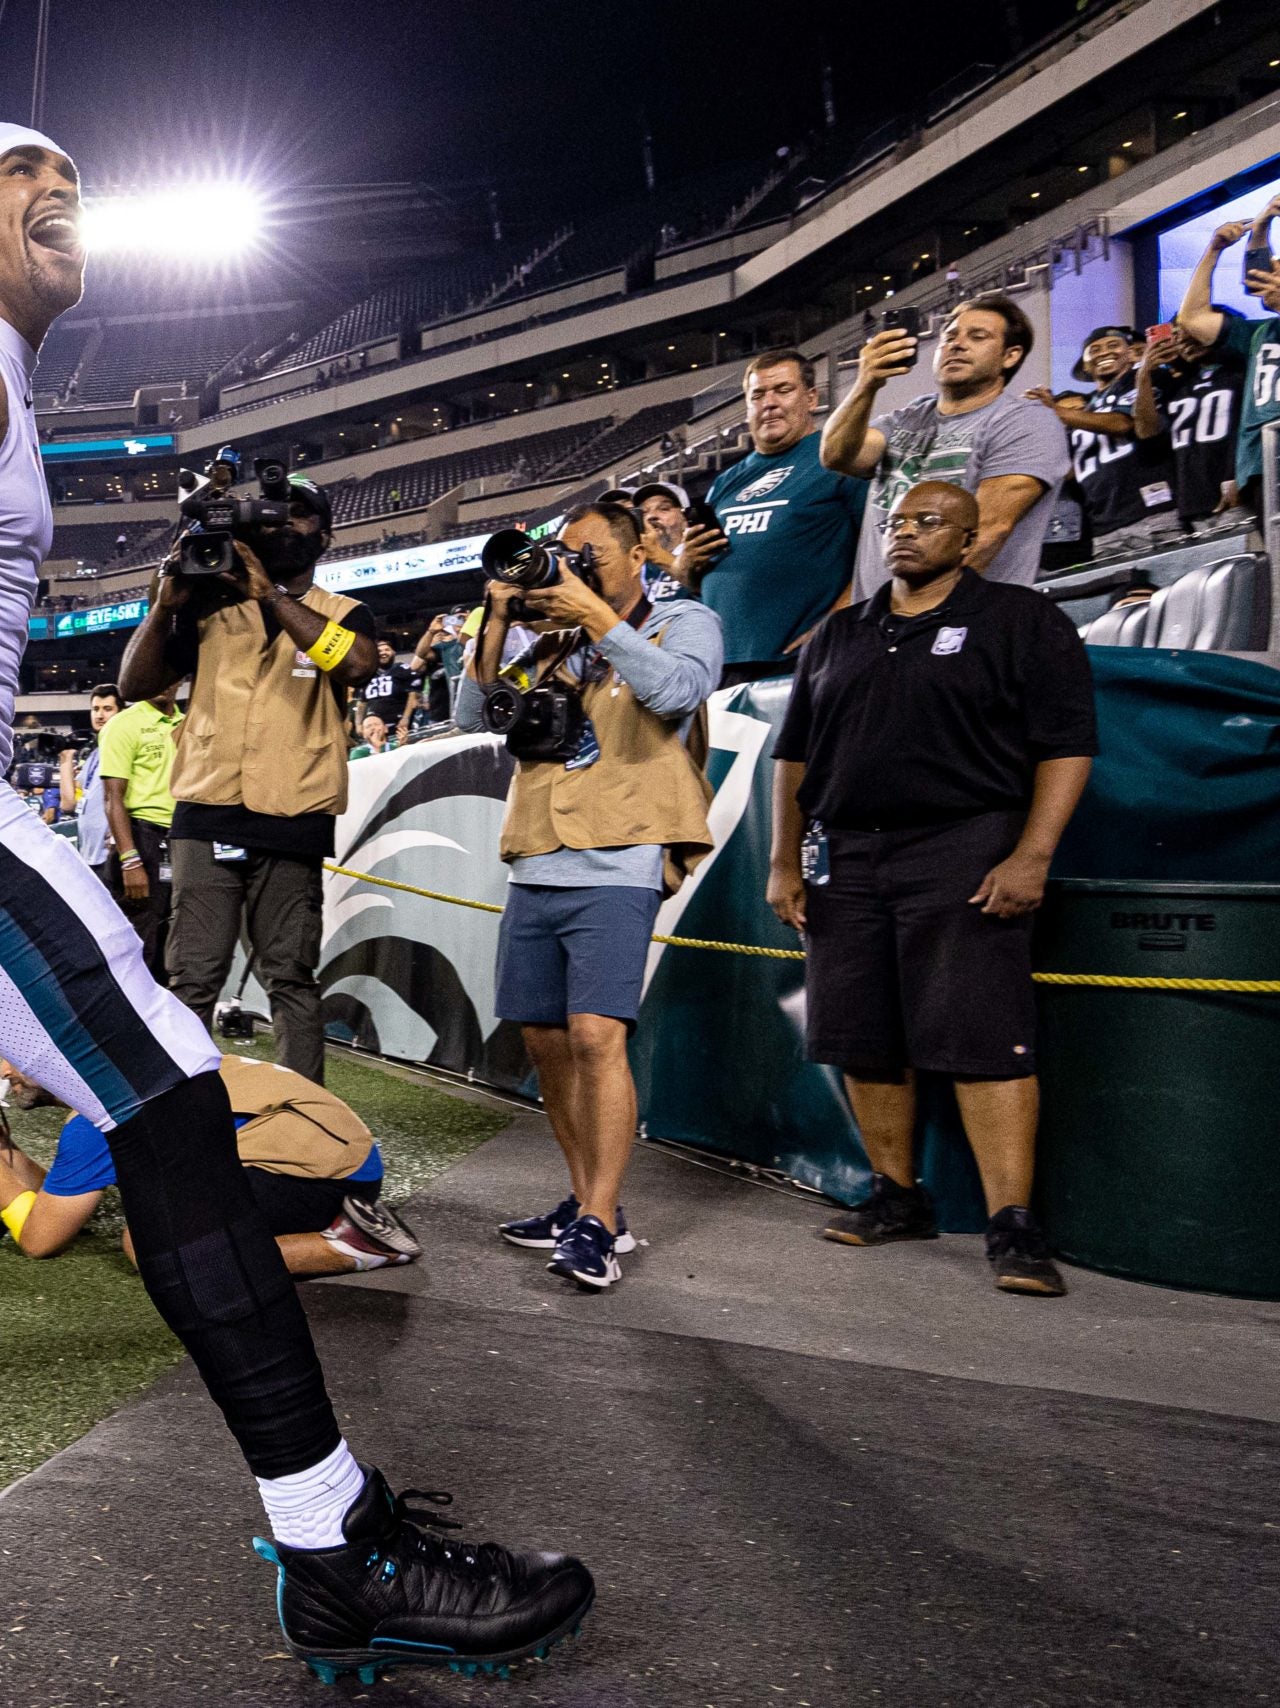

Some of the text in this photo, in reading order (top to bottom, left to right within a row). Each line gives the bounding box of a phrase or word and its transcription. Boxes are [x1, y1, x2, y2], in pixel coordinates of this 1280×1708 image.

[1253, 343, 1280, 407] 6
[1168, 389, 1233, 450] 20
[724, 510, 773, 536] PHI
[322, 633, 342, 655] WEEK
[1111, 912, 1215, 931] BRUTE
